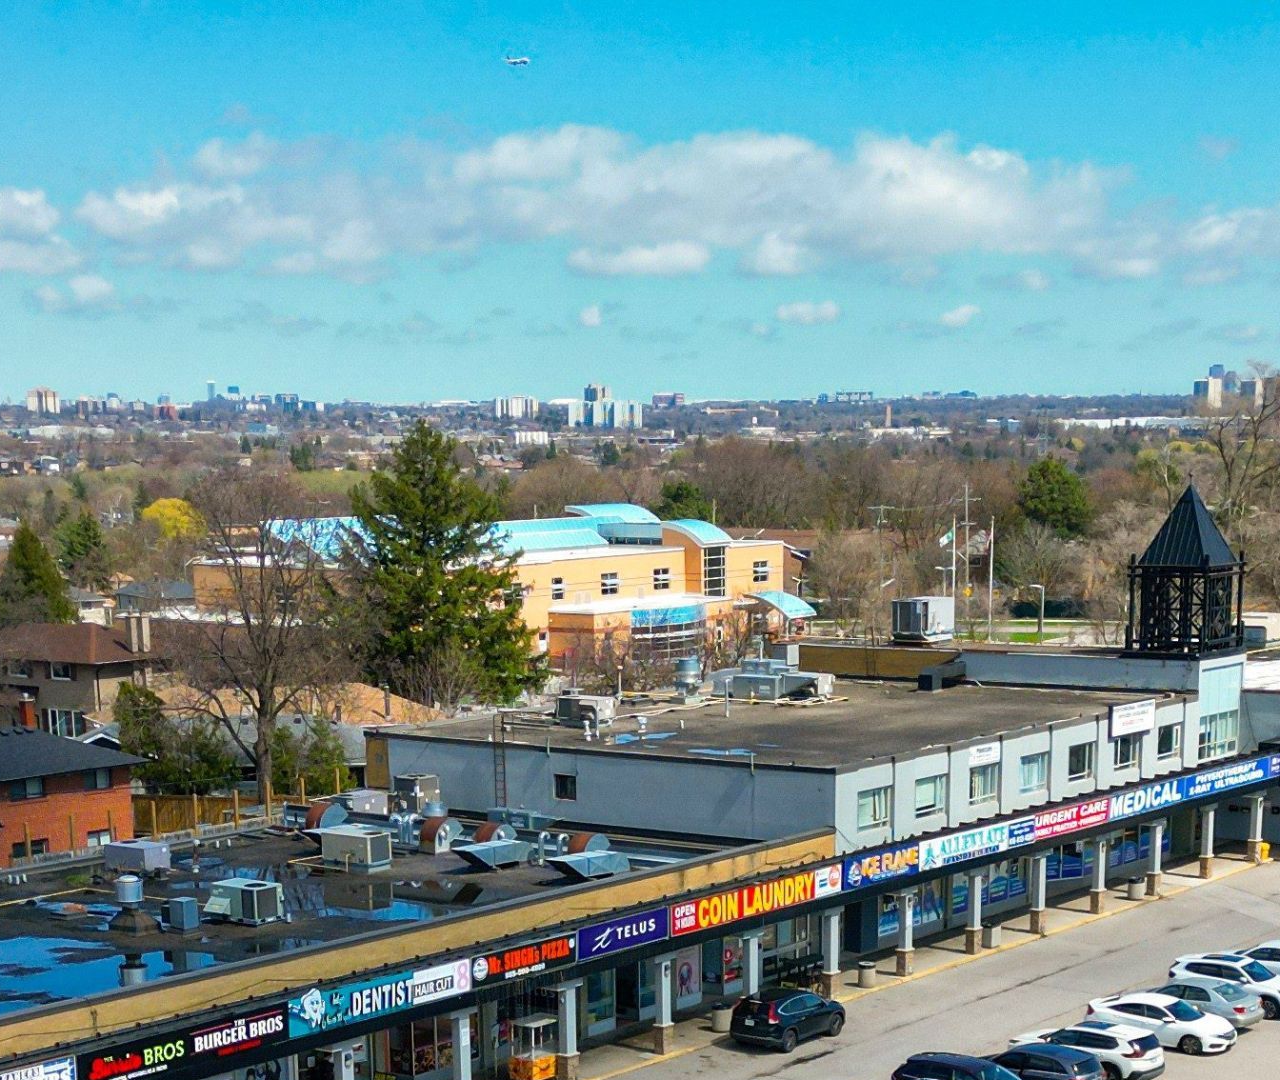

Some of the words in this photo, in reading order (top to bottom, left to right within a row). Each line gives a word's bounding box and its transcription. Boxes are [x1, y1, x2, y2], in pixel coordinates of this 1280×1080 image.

[1196, 762, 1257, 784] PHYSIOTHERAPY
[1214, 769, 1264, 790] ULTRASOUND
[1110, 781, 1181, 818] MEDICAL
[1035, 807, 1078, 827] URGENT
[1080, 800, 1108, 817] CARE
[861, 855, 880, 876] ICE
[882, 847, 919, 871] FLAME
[675, 903, 695, 918] OPEN
[698, 892, 738, 928] COIN
[743, 873, 814, 916] LAUNDRY
[616, 919, 656, 940] TELUS
[541, 938, 570, 961] PIZZA
[352, 979, 413, 1017] DENTIST
[414, 982, 435, 997] HAIR
[435, 976, 453, 991] CUT
[194, 1025, 247, 1052] BURGER
[250, 1015, 284, 1038] BROS
[144, 1040, 185, 1066] BROS
